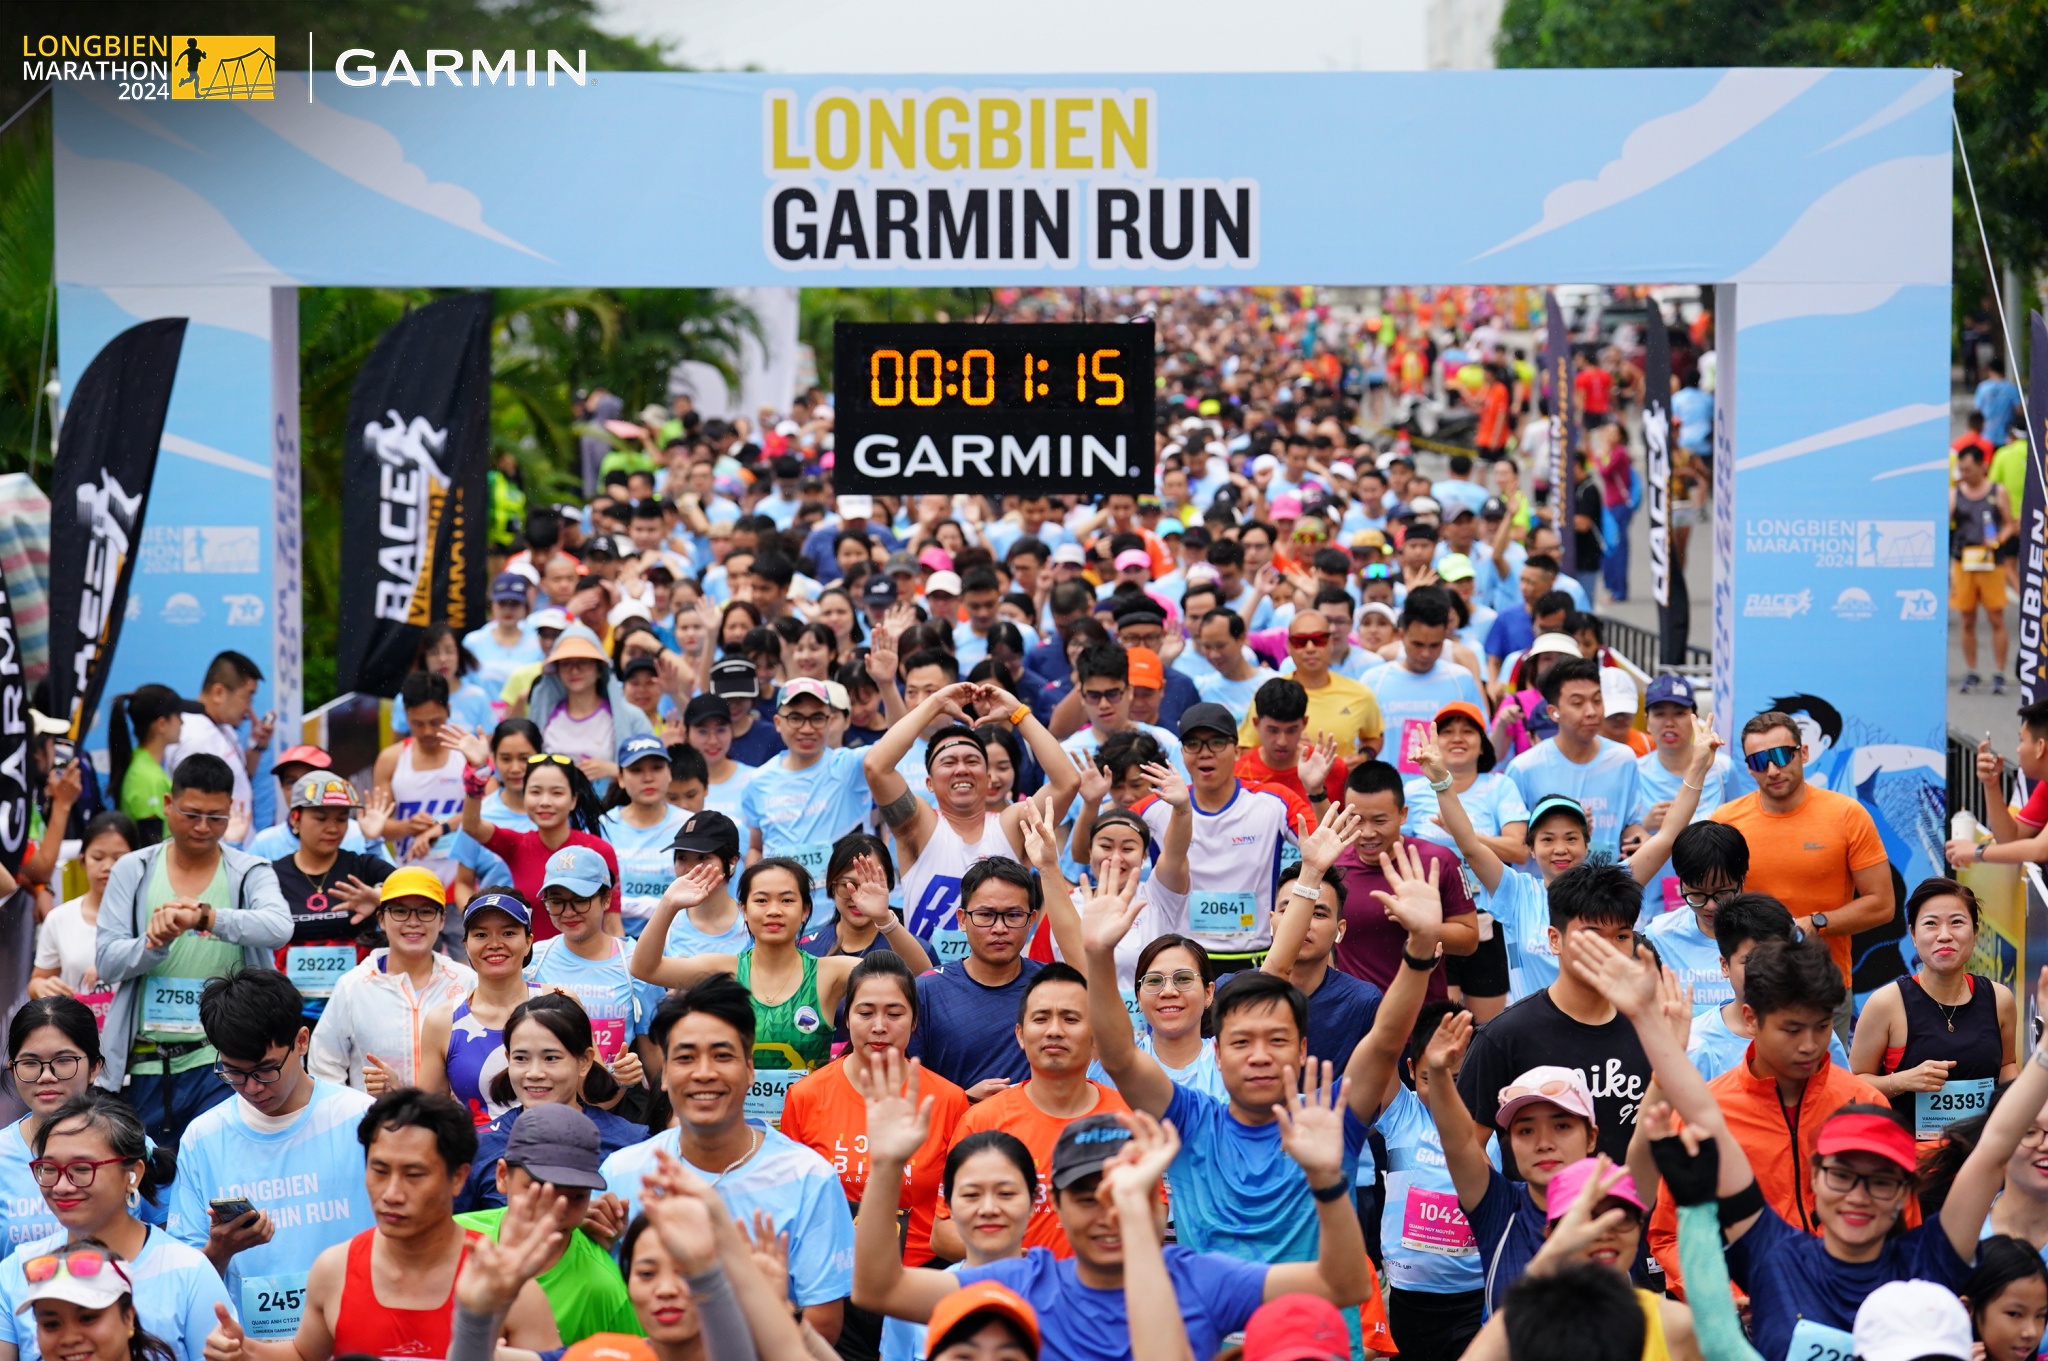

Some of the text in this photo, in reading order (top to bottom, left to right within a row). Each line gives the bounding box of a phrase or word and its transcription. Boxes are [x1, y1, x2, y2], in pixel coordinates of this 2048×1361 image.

[772, 97, 1148, 171] LONGBIEN
[772, 187, 1250, 261] GARMIN RUN
[853, 434, 1126, 477] GARMIN
[1746, 519, 1854, 537] LONGBIEN
[375, 463, 419, 622] RACE
[1746, 538, 1854, 553] MARATHON
[1815, 554, 1854, 568] 2024
[0, 565, 27, 853] GARM
[1231, 835, 1256, 845] VNPAY
[1200, 902, 1245, 915] 20641
[297, 957, 346, 971] 29222
[593, 1030, 612, 1046] 12
[1930, 1092, 1985, 1111] 29393
[218, 1172, 319, 1201] LONGBIEN
[305, 1198, 350, 1224] RUN
[1409, 1223, 1425, 1231] QUANG
